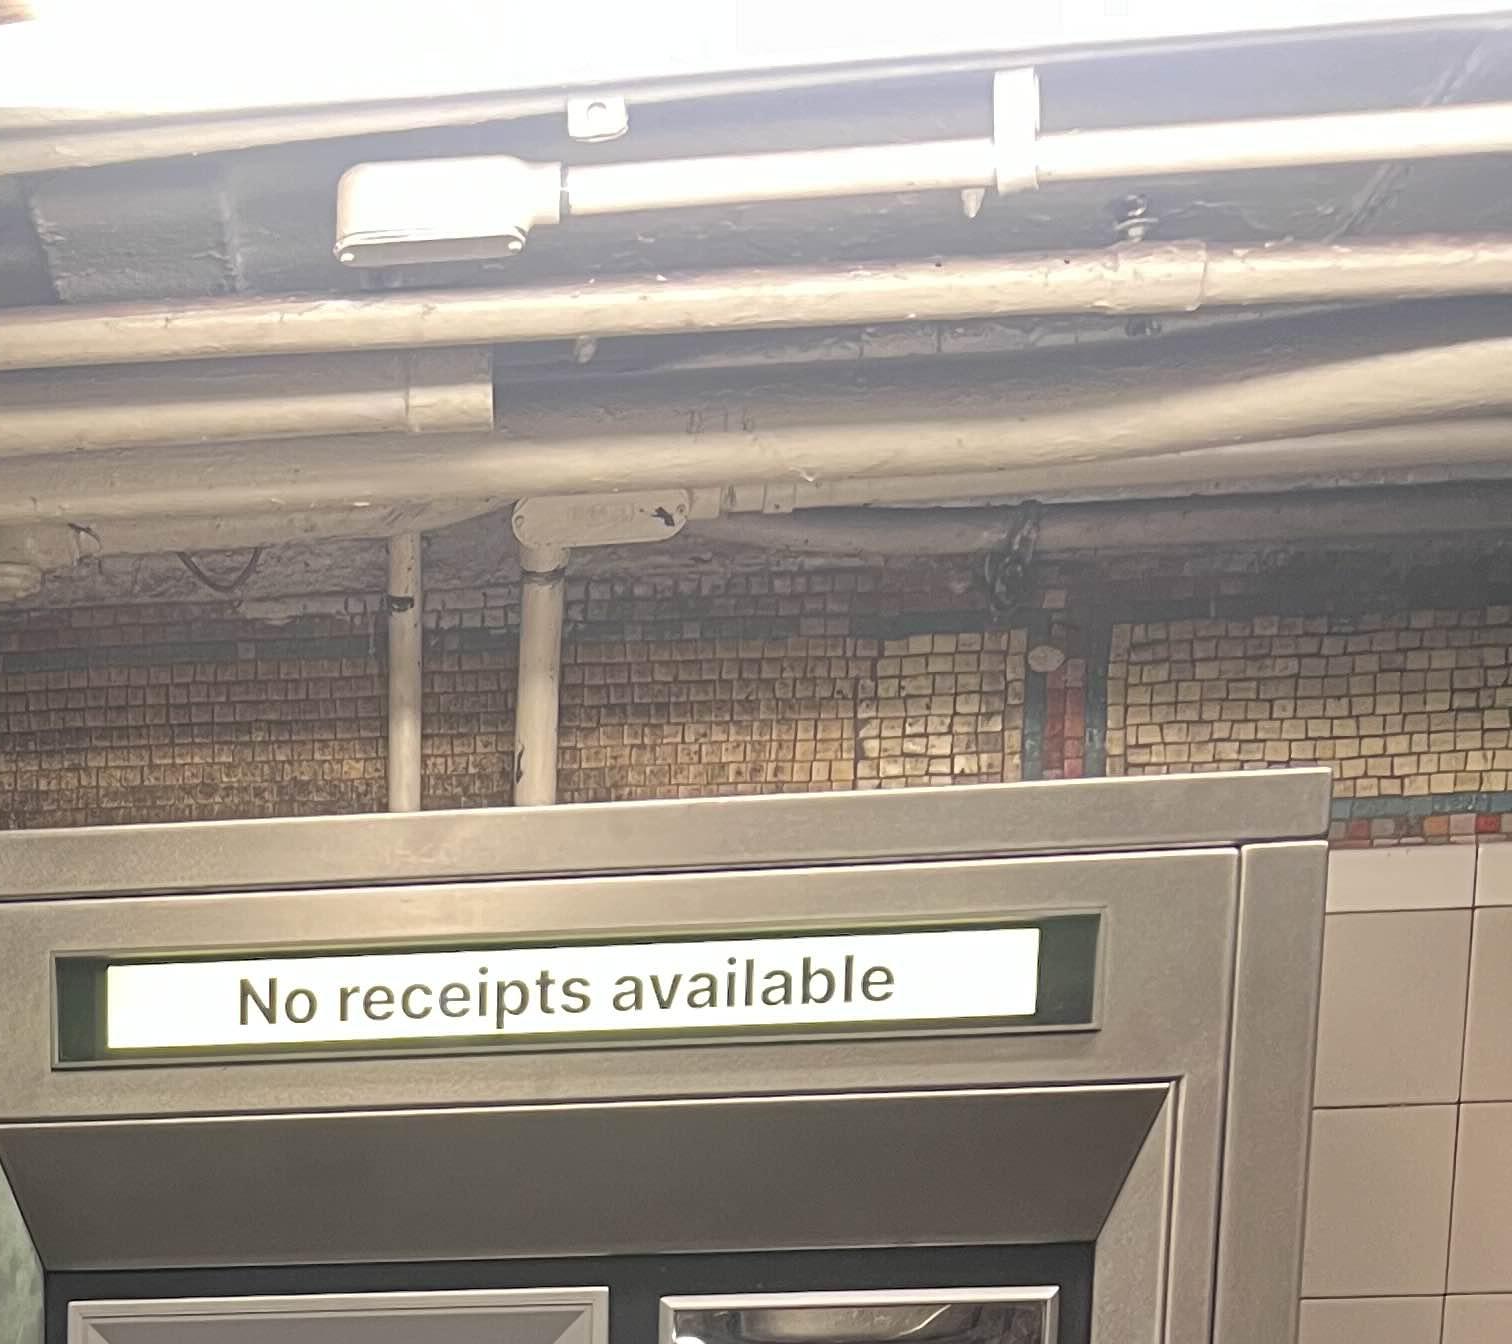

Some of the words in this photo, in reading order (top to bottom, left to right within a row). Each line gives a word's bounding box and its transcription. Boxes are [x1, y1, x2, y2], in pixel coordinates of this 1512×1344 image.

[237, 976, 319, 1026] No
[339, 964, 591, 1030] receipts
[614, 953, 896, 1014] available
